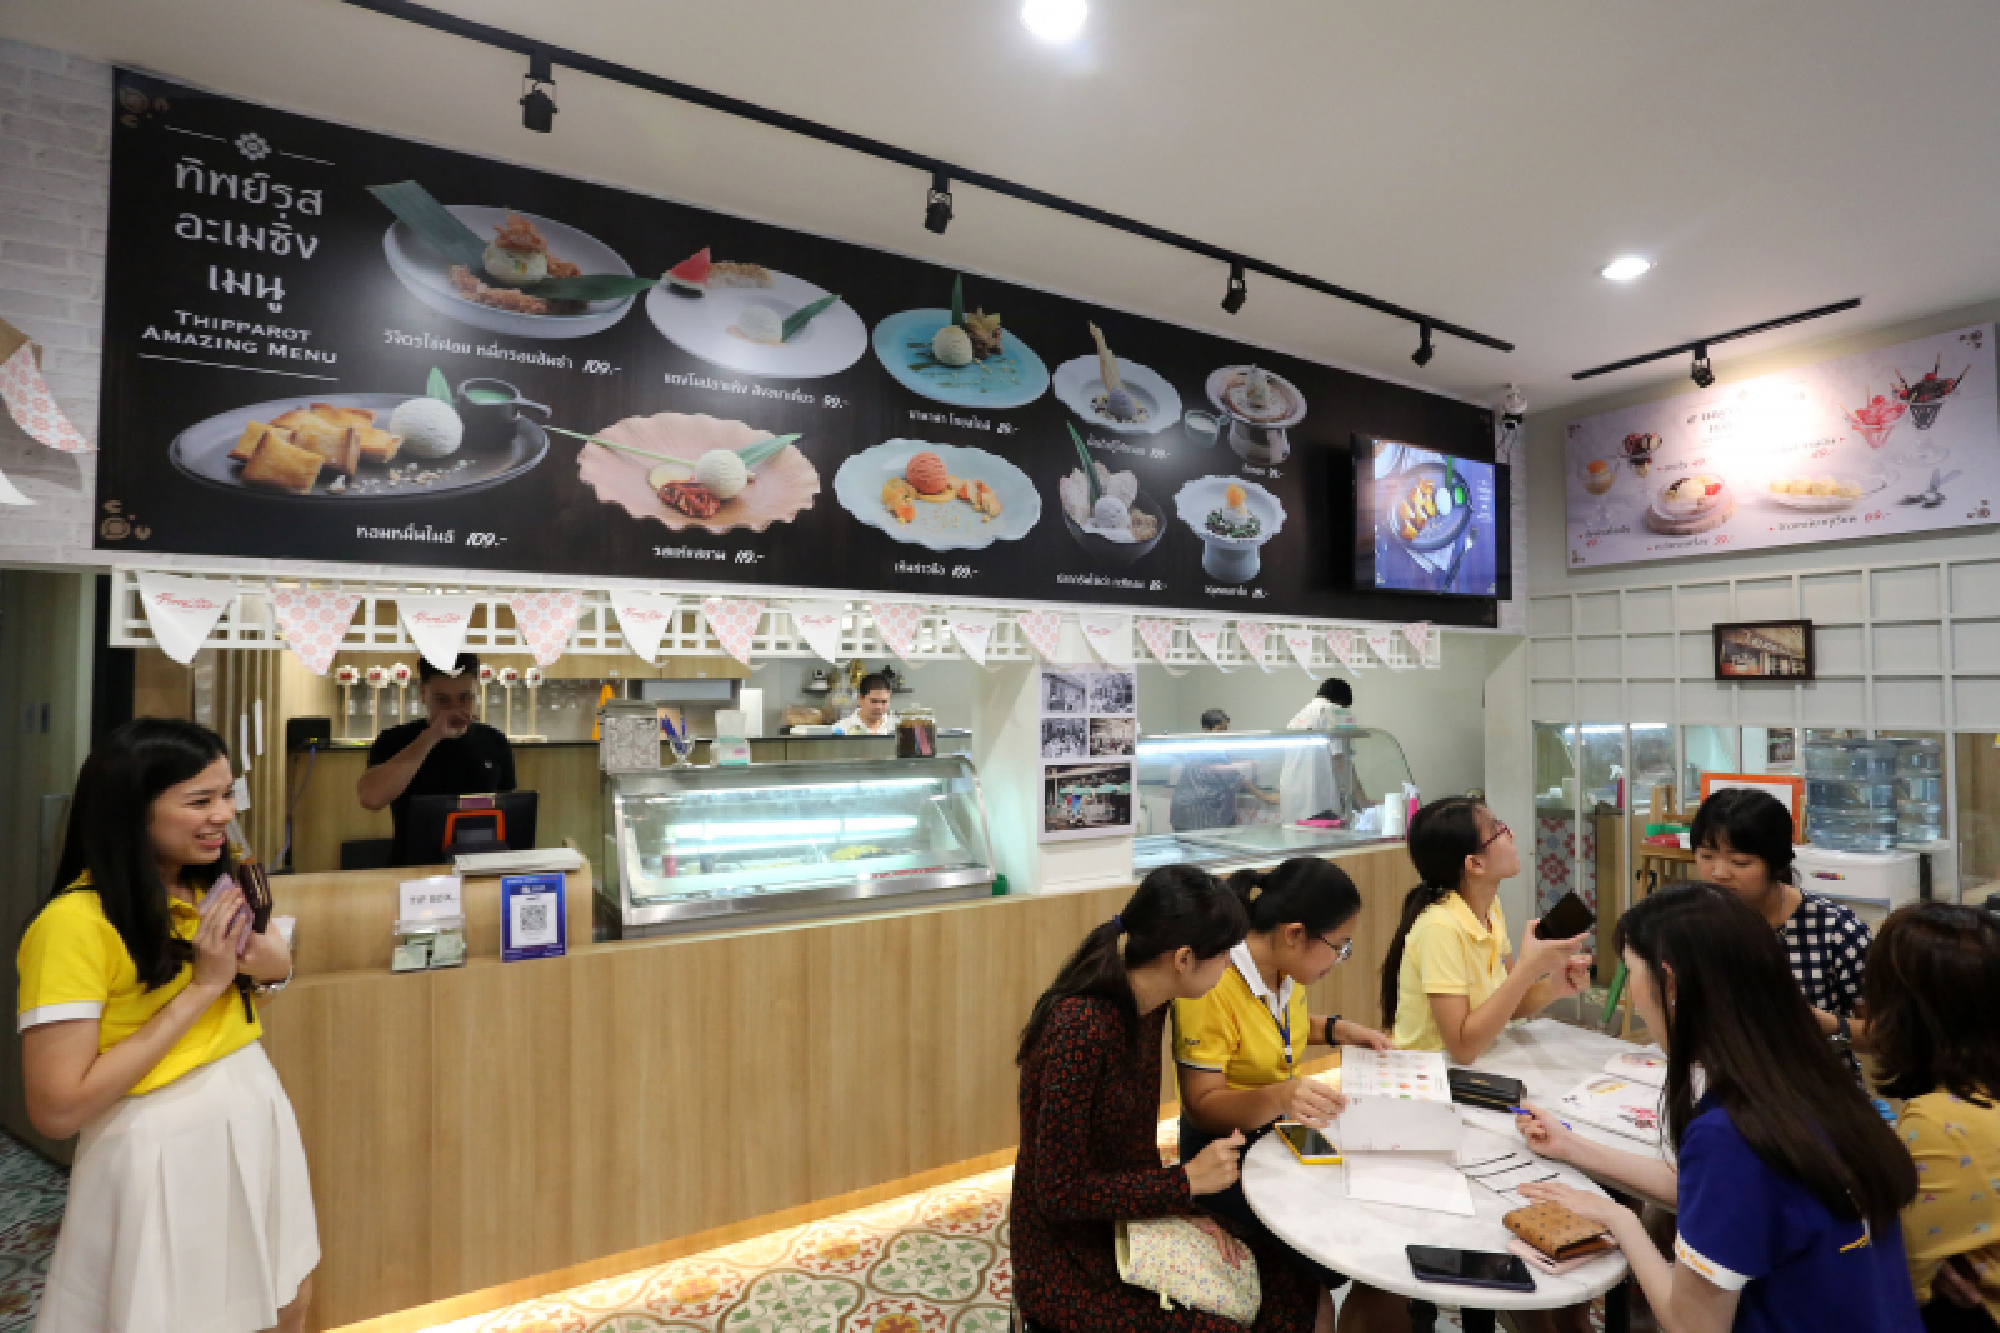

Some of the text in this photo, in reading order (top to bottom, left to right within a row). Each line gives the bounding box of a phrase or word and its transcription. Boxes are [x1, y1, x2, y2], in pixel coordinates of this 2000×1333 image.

[174, 212, 319, 260] อะเมซิ่ง
[208, 264, 286, 314] เมนู
[141, 325, 338, 364] AMAZING MENU
[174, 309, 311, 342] THIPPAROT
